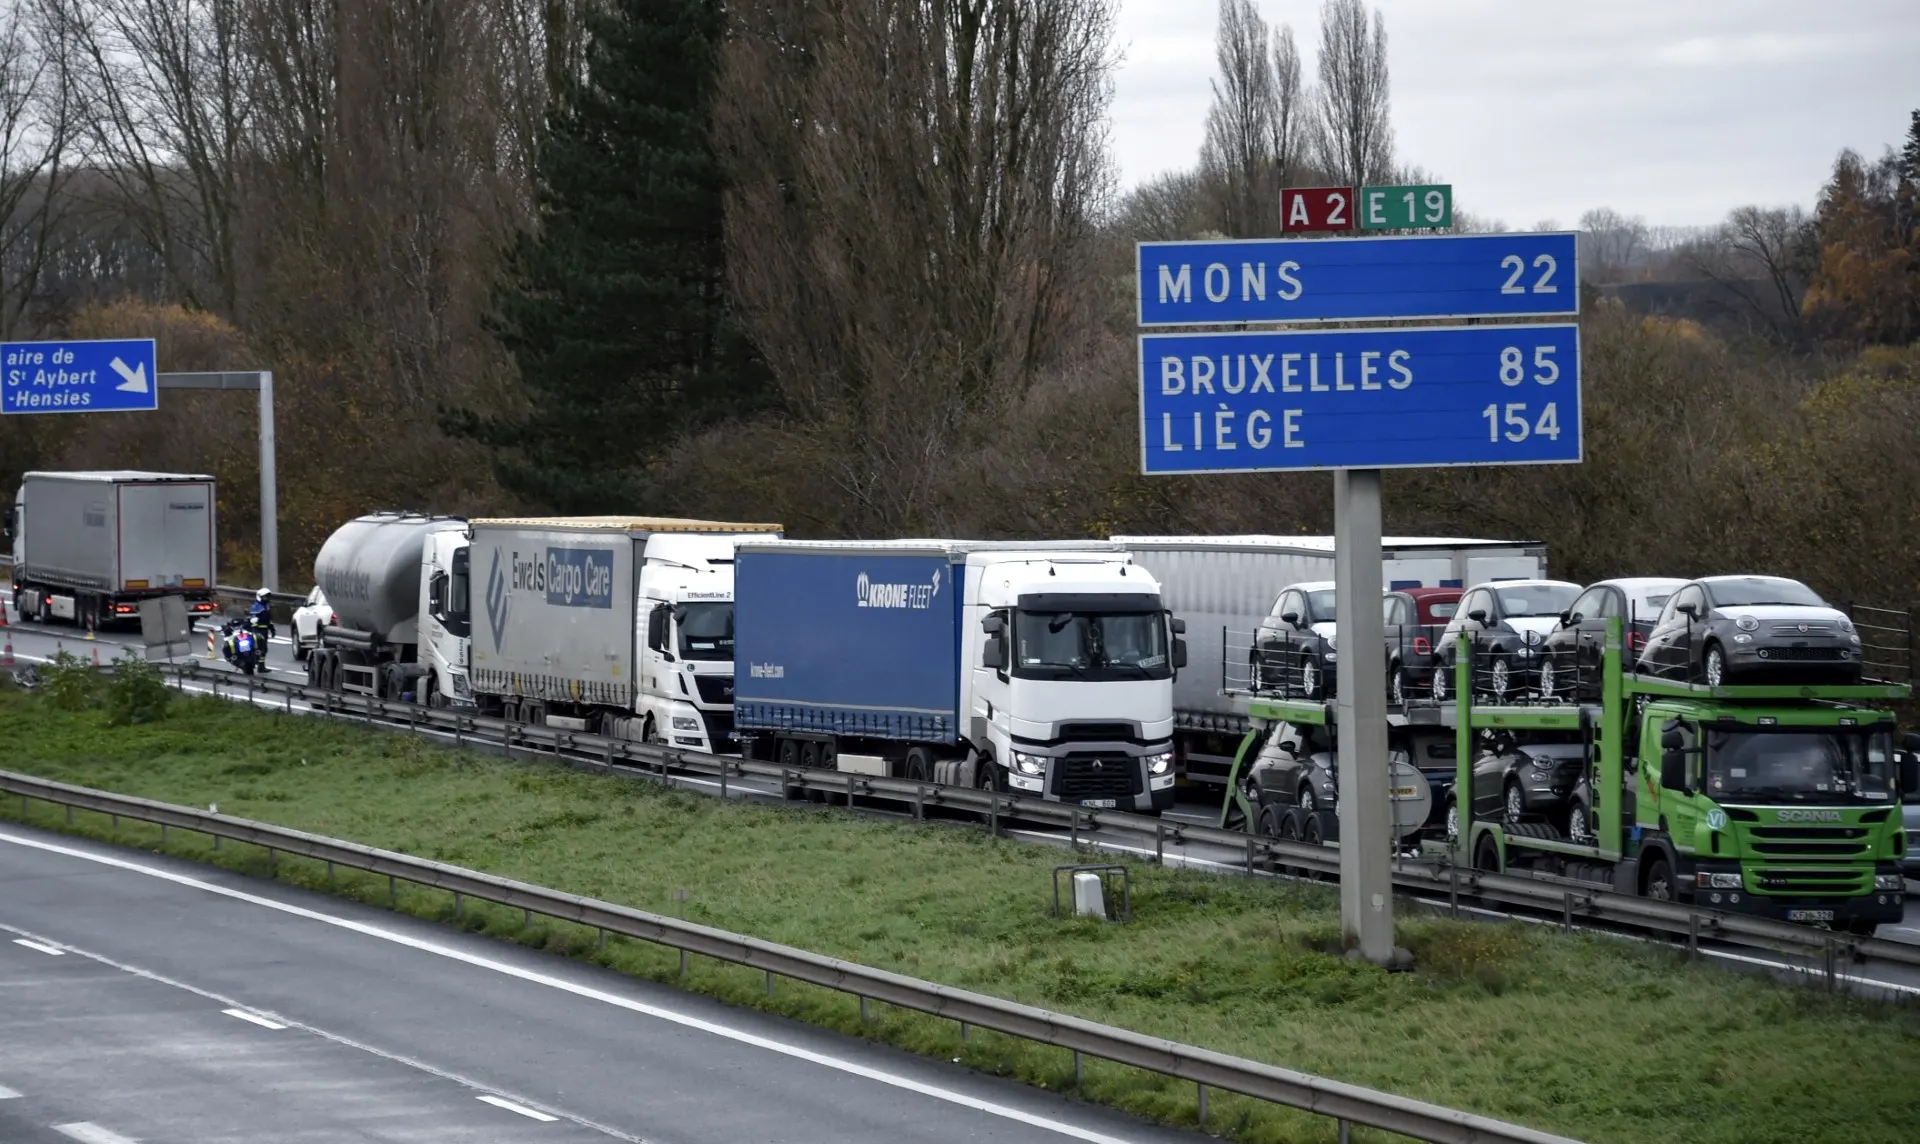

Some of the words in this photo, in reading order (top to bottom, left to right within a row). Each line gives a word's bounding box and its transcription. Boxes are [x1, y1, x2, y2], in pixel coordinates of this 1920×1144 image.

[1289, 194, 1309, 225] A
[1326, 193, 1347, 225] 2
[1369, 192, 1387, 224] E
[1403, 190, 1445, 223] 19
[1158, 260, 1303, 304] MONS
[1501, 254, 1558, 294] 22
[7, 349, 44, 366] aire
[52, 348, 75, 364] de
[1161, 349, 1413, 395] BRUXELLES
[1499, 346, 1559, 387] 85
[8, 369, 27, 387] St
[33, 368, 97, 389] Aybert
[1163, 402, 1305, 451] LIÈGE
[1482, 402, 1560, 443] 154
[512, 551, 545, 592] Ewals
[548, 552, 581, 604] Cargo
[585, 555, 611, 597] Care
[869, 583, 908, 609] KRONE
[908, 584, 932, 609] FLEET
[1777, 809, 1842, 822] SCANIA
